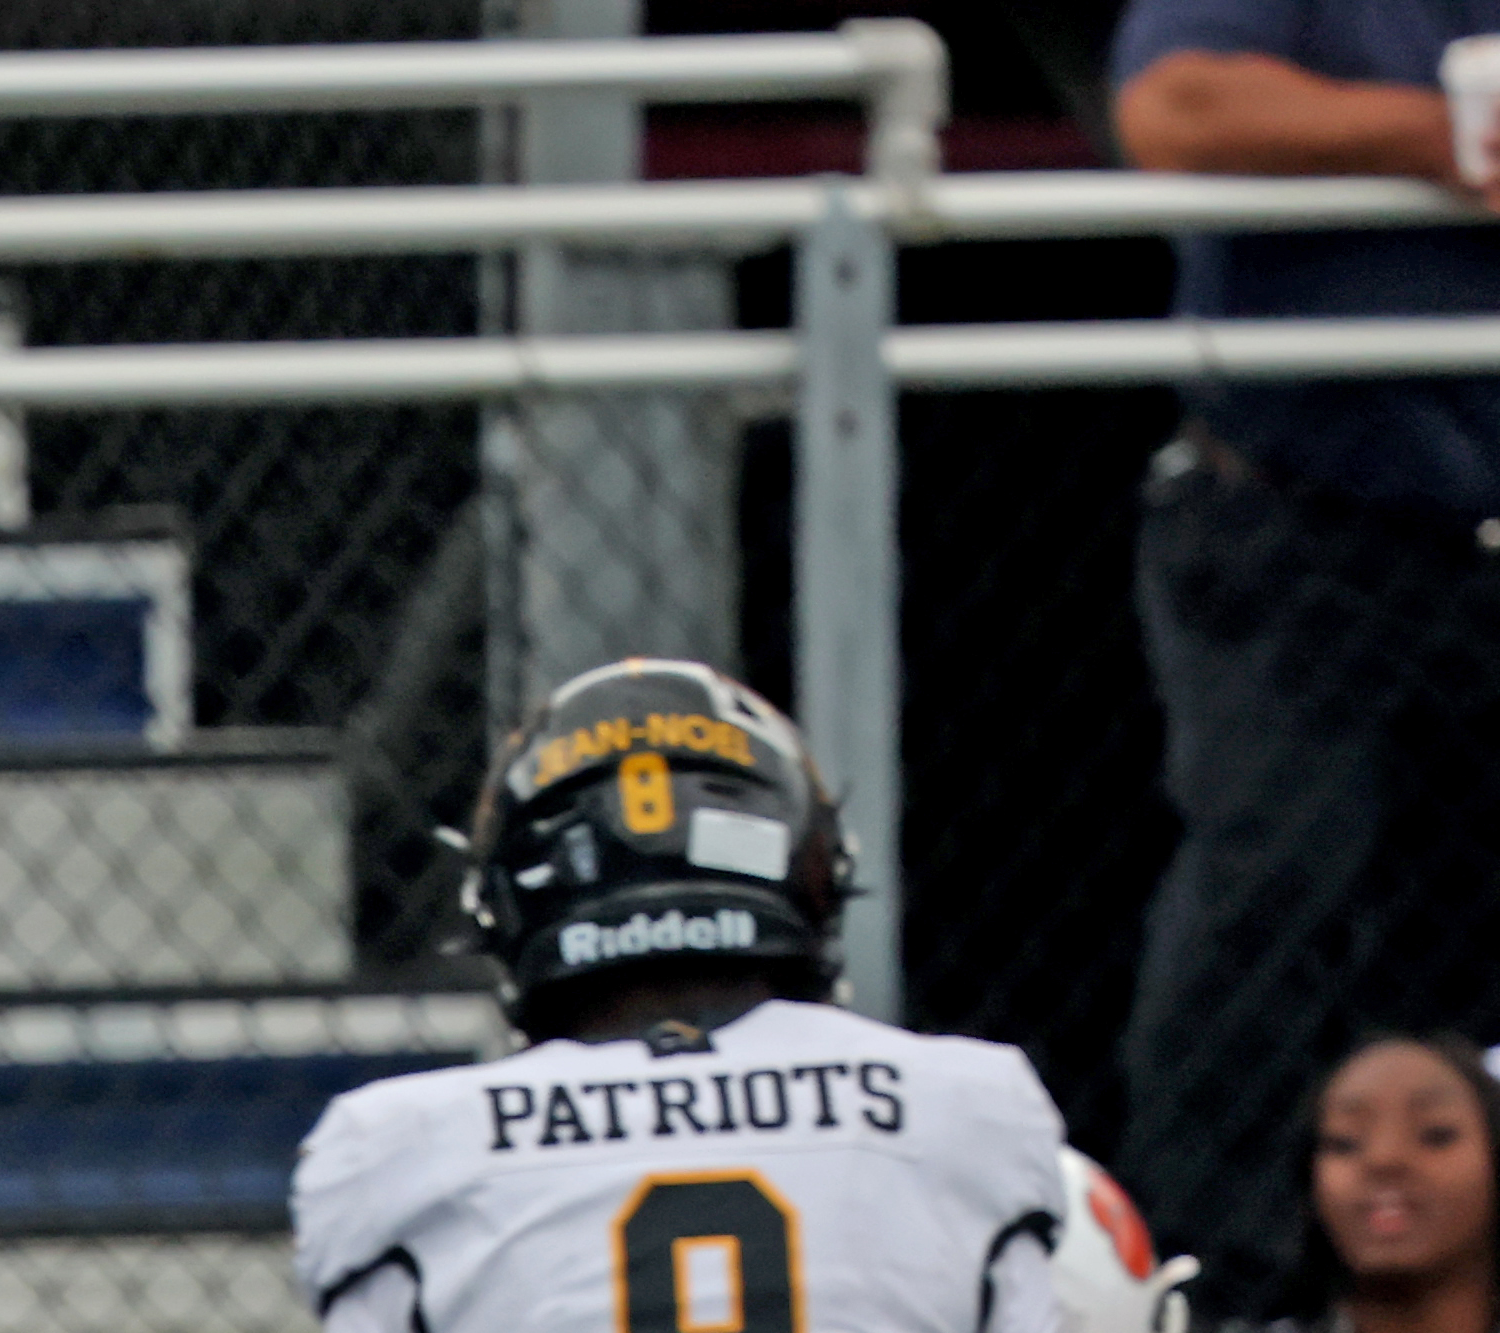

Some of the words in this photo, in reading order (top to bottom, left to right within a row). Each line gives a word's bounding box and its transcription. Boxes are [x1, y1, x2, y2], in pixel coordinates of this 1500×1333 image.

[533, 712, 758, 787] JEAN-NOEL
[617, 750, 676, 834] 8
[559, 908, 758, 967] Riddell
[483, 1060, 905, 1152] PATRIOTS
